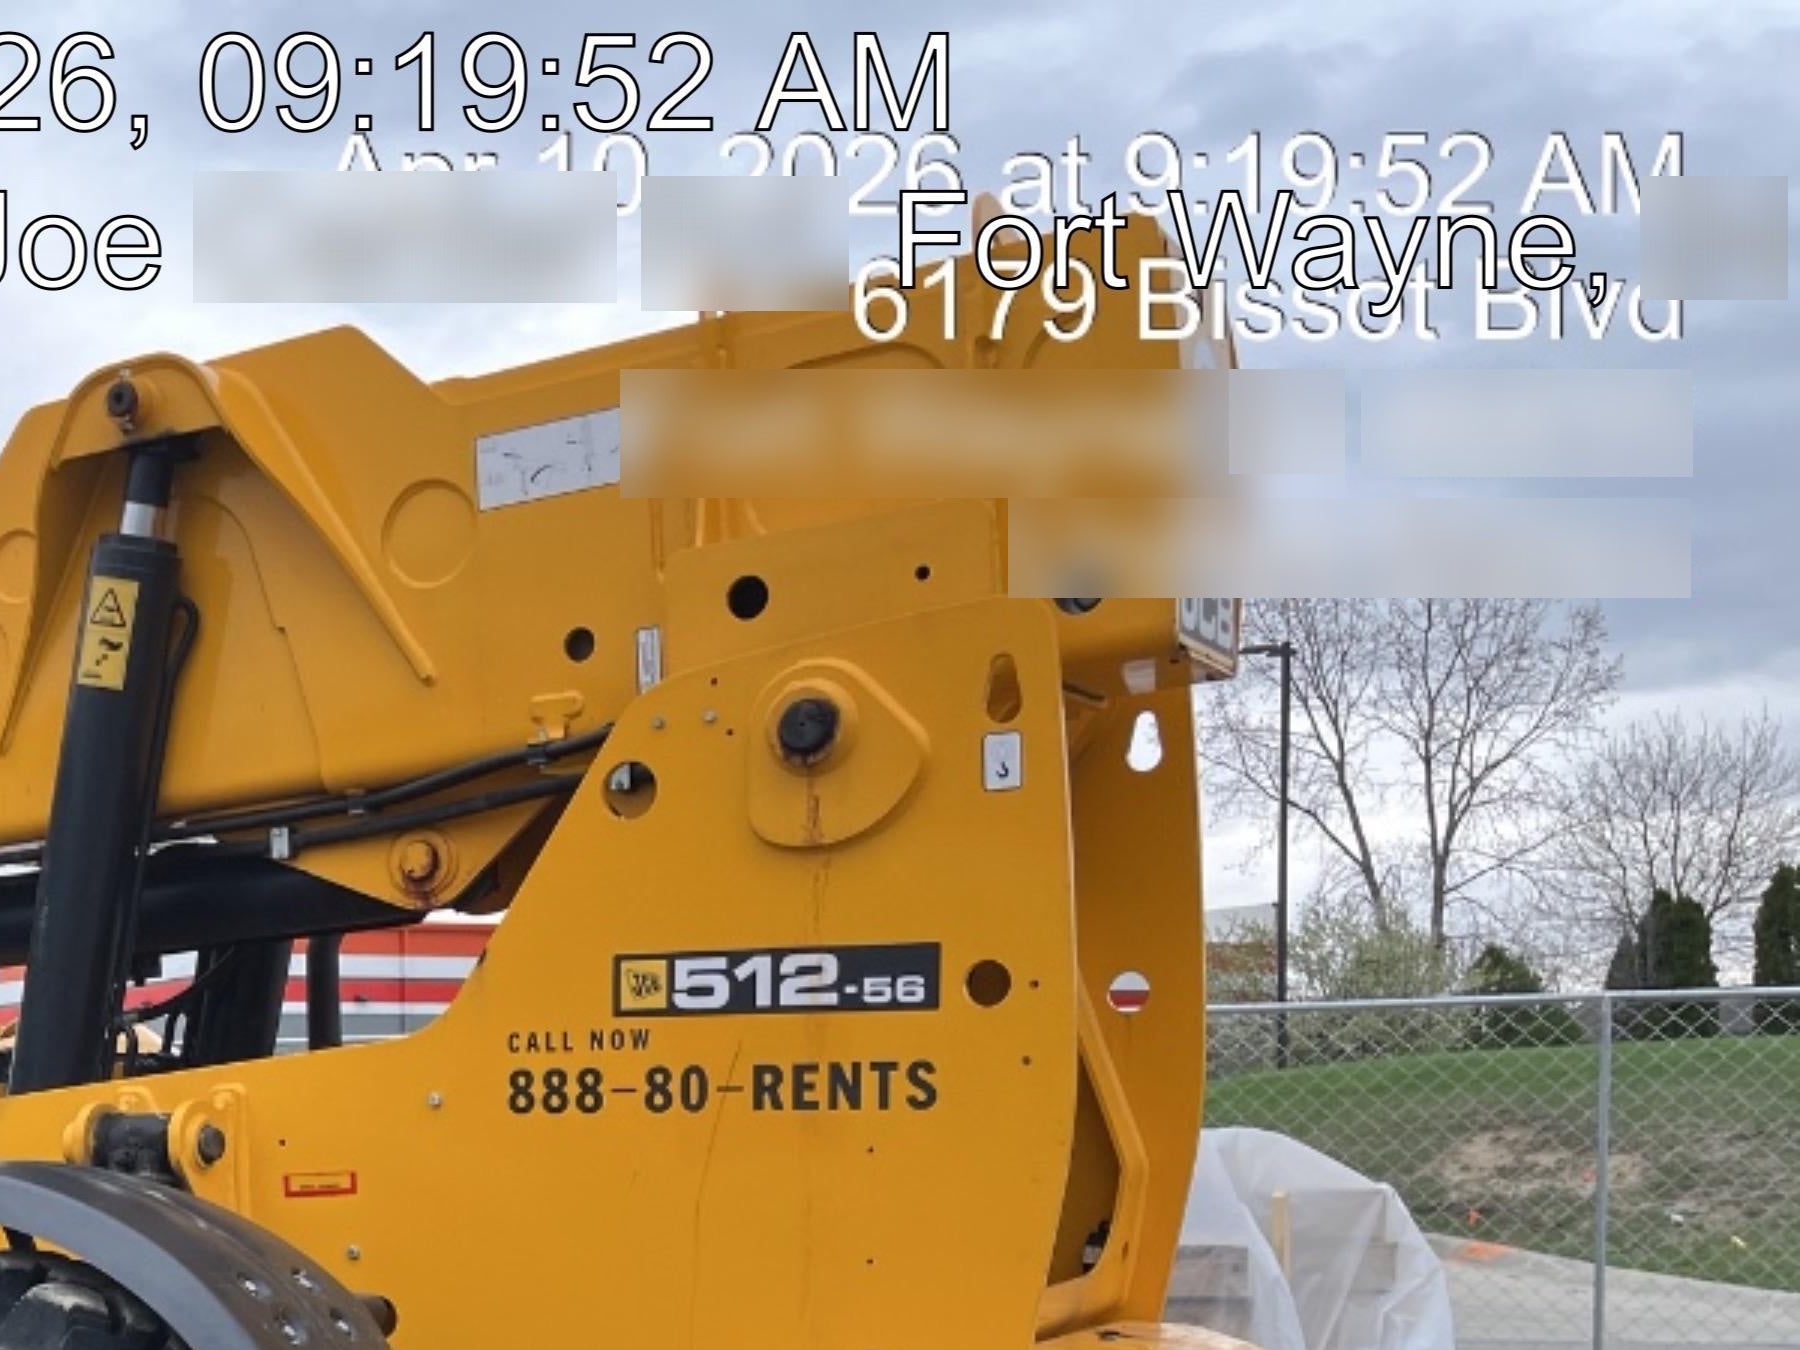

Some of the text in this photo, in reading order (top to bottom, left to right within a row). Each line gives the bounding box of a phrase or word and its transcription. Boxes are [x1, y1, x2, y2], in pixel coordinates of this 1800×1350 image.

[672, 952, 926, 1010] 512-56
[508, 1028, 652, 1054] CALL NOW
[508, 1058, 938, 1114] 888-80-RENTS
